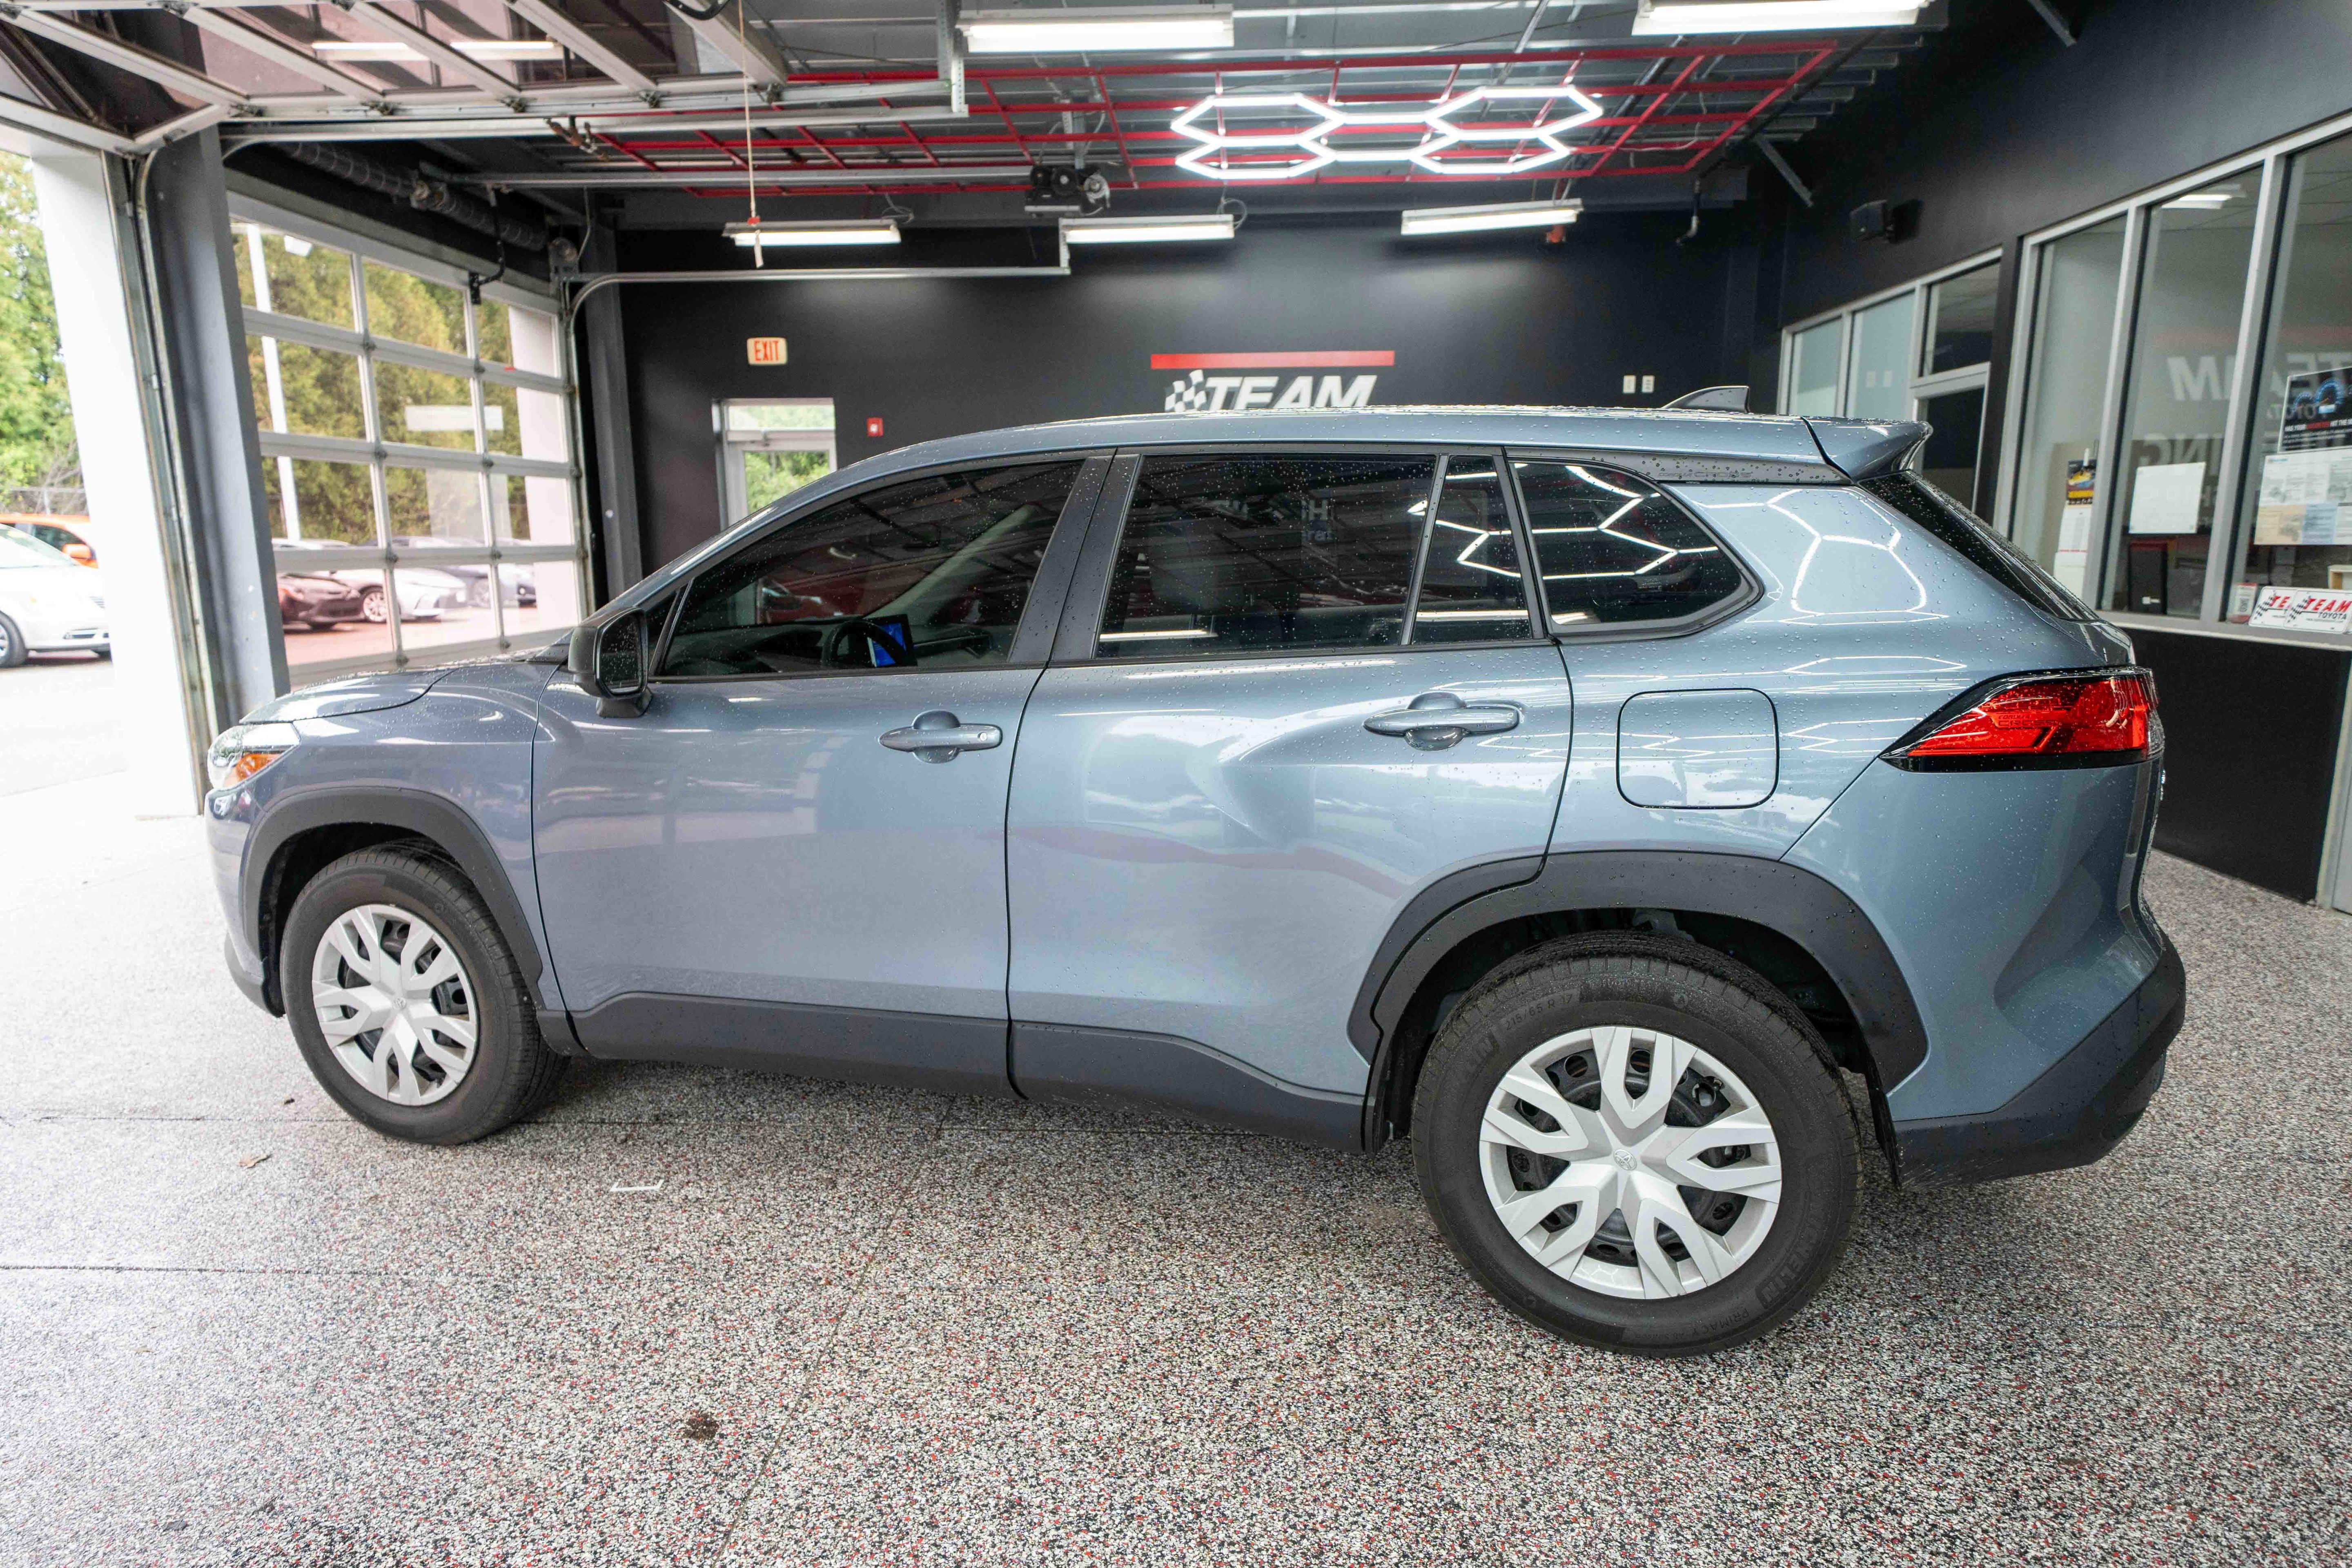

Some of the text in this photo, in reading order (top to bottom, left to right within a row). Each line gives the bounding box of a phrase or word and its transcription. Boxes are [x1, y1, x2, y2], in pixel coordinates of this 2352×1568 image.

[754, 340, 779, 361] EXIT
[1205, 374, 1378, 410] TEAM
[2303, 598, 2352, 613] TEAM
[2318, 612, 2347, 620] TOYOTA
[1561, 994, 1573, 1005] 17
[1693, 1308, 1750, 1337] PRIMACY
